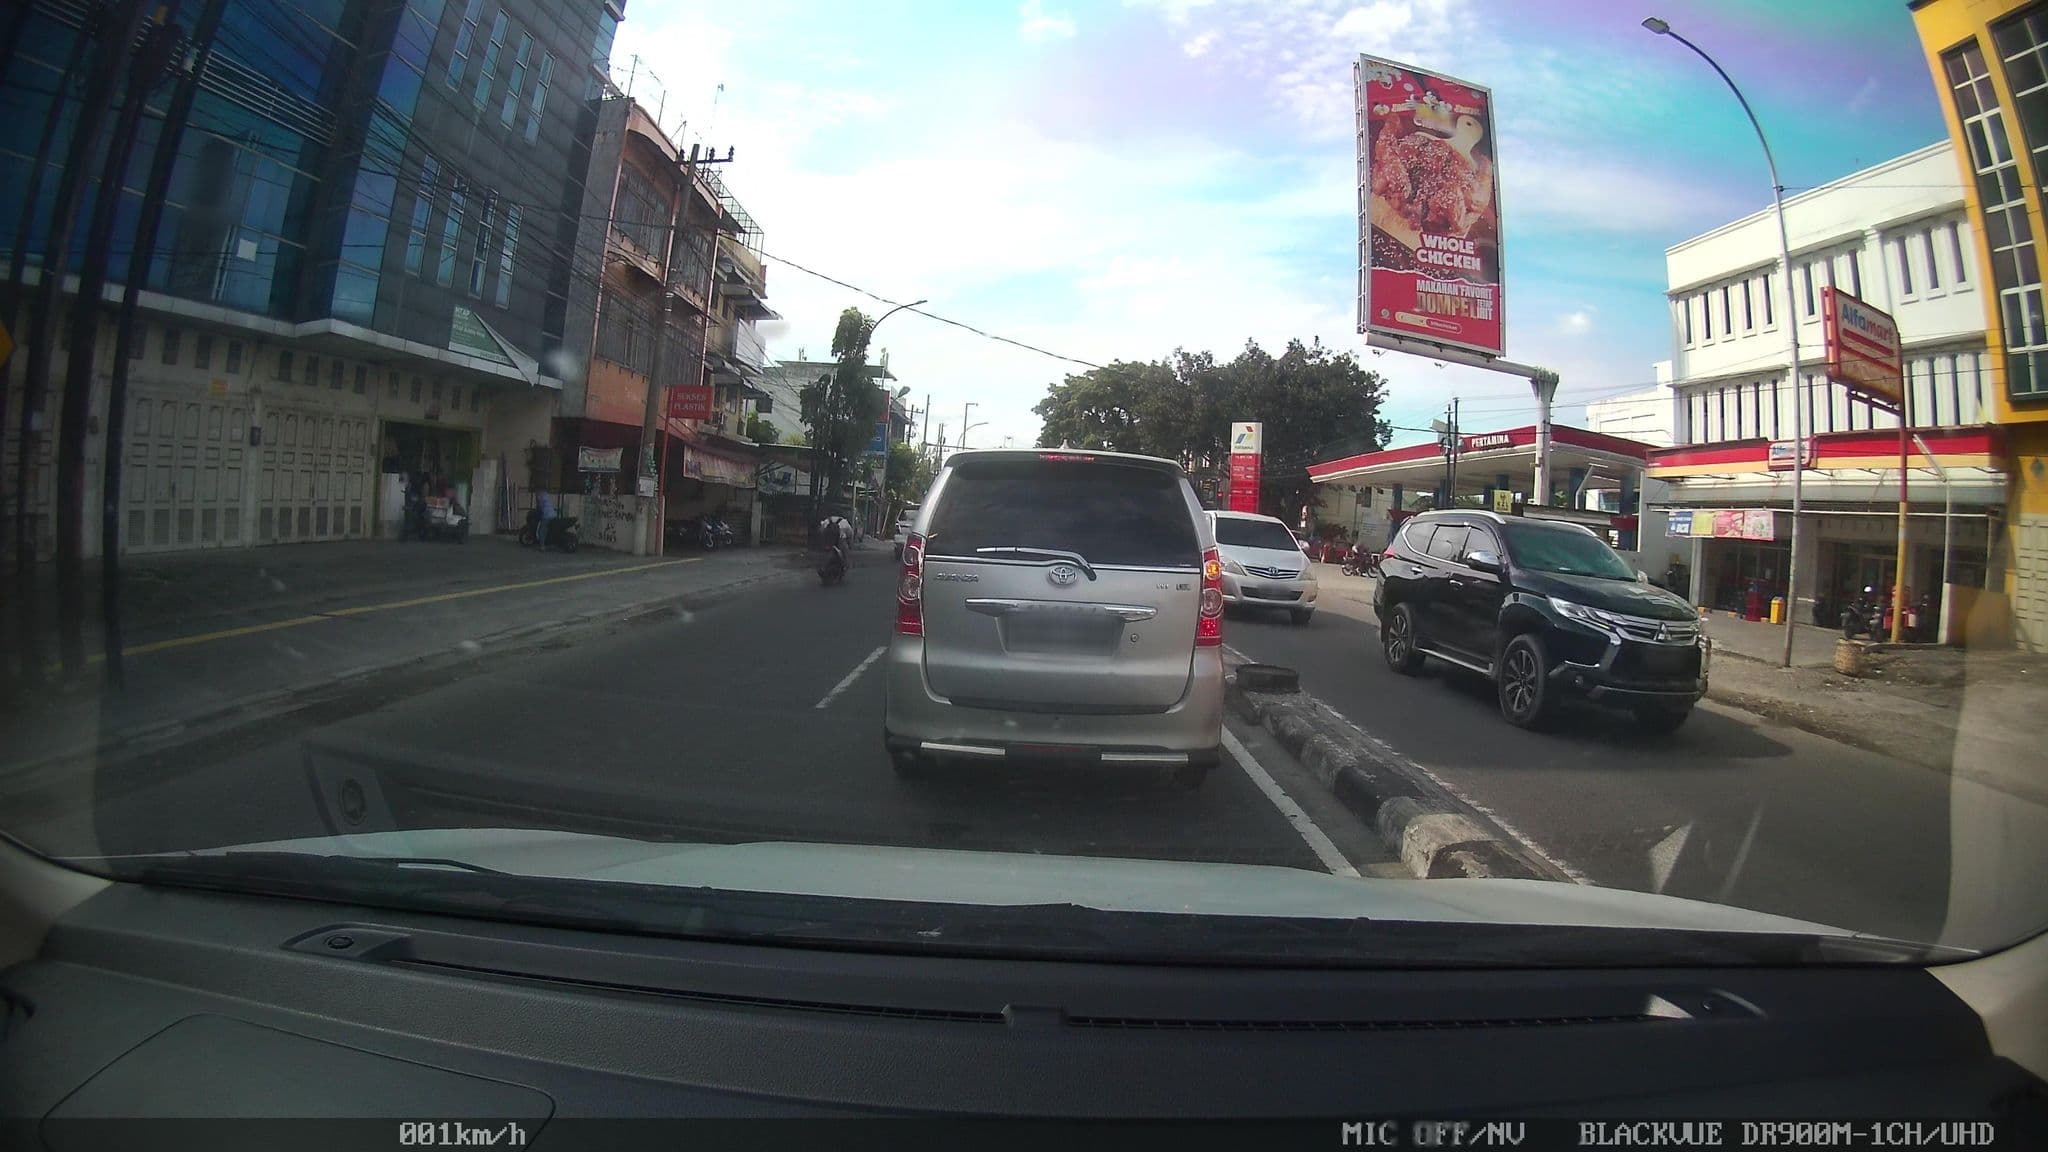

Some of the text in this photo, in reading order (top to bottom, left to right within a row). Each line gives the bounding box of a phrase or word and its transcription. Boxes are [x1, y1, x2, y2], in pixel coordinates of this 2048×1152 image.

[1422, 234, 1475, 255] WHOLE
[1416, 248, 1481, 271] CHICKEN
[1416, 279, 1493, 300] MAKANAN FAVORIT
[1842, 303, 1894, 345] Alfamart
[1471, 434, 1510, 448] PERTAMINA
[934, 572, 980, 583] AVANZA
